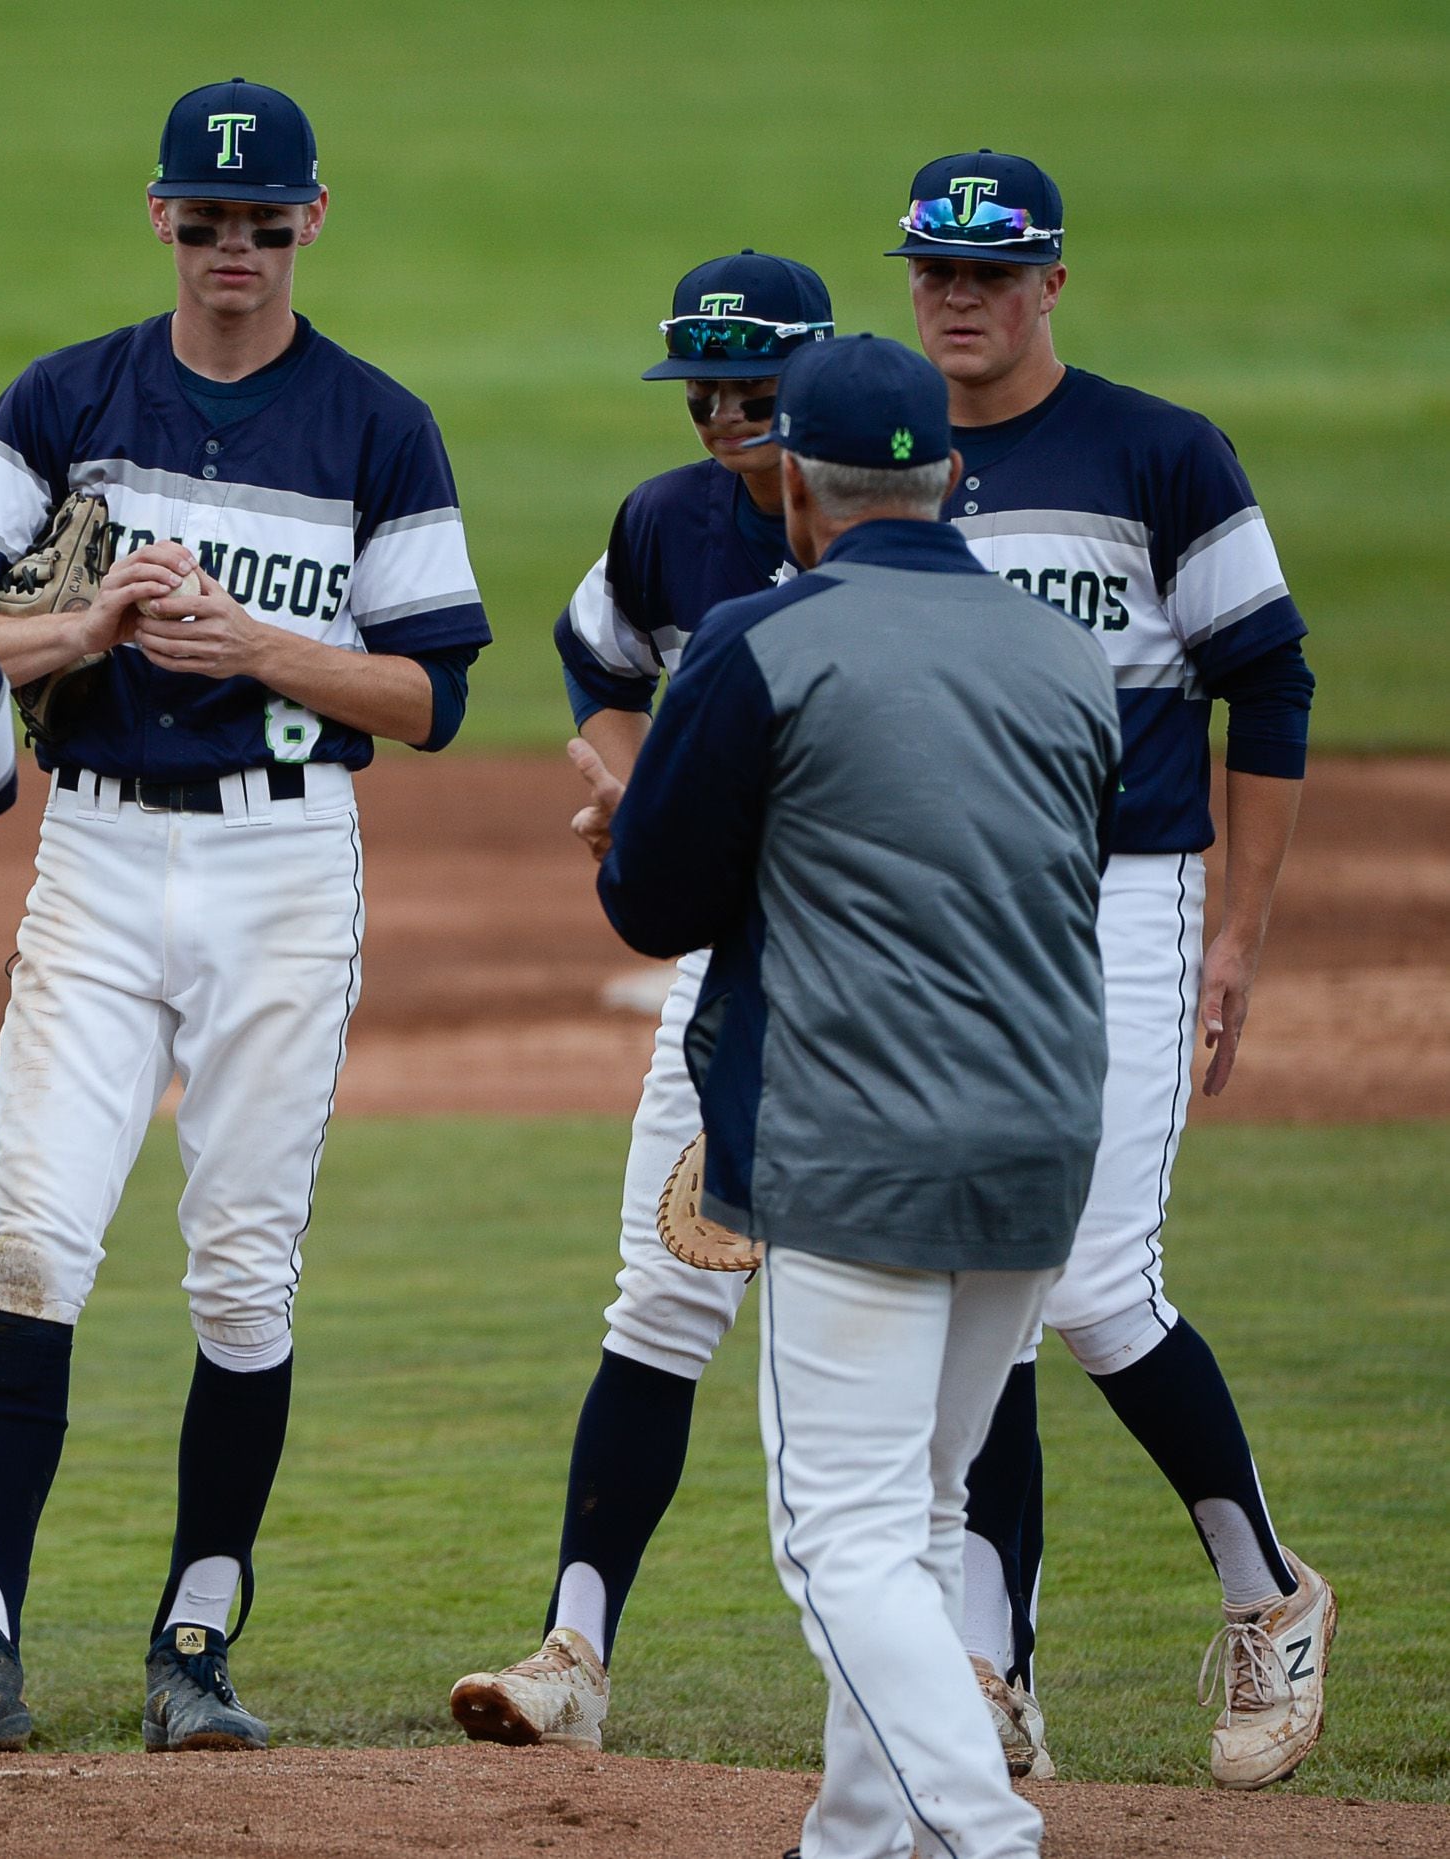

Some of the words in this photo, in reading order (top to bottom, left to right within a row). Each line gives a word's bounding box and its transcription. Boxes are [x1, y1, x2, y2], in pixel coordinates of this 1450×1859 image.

[207, 113, 257, 169] T
[949, 177, 998, 226] T
[264, 699, 323, 764] 8
